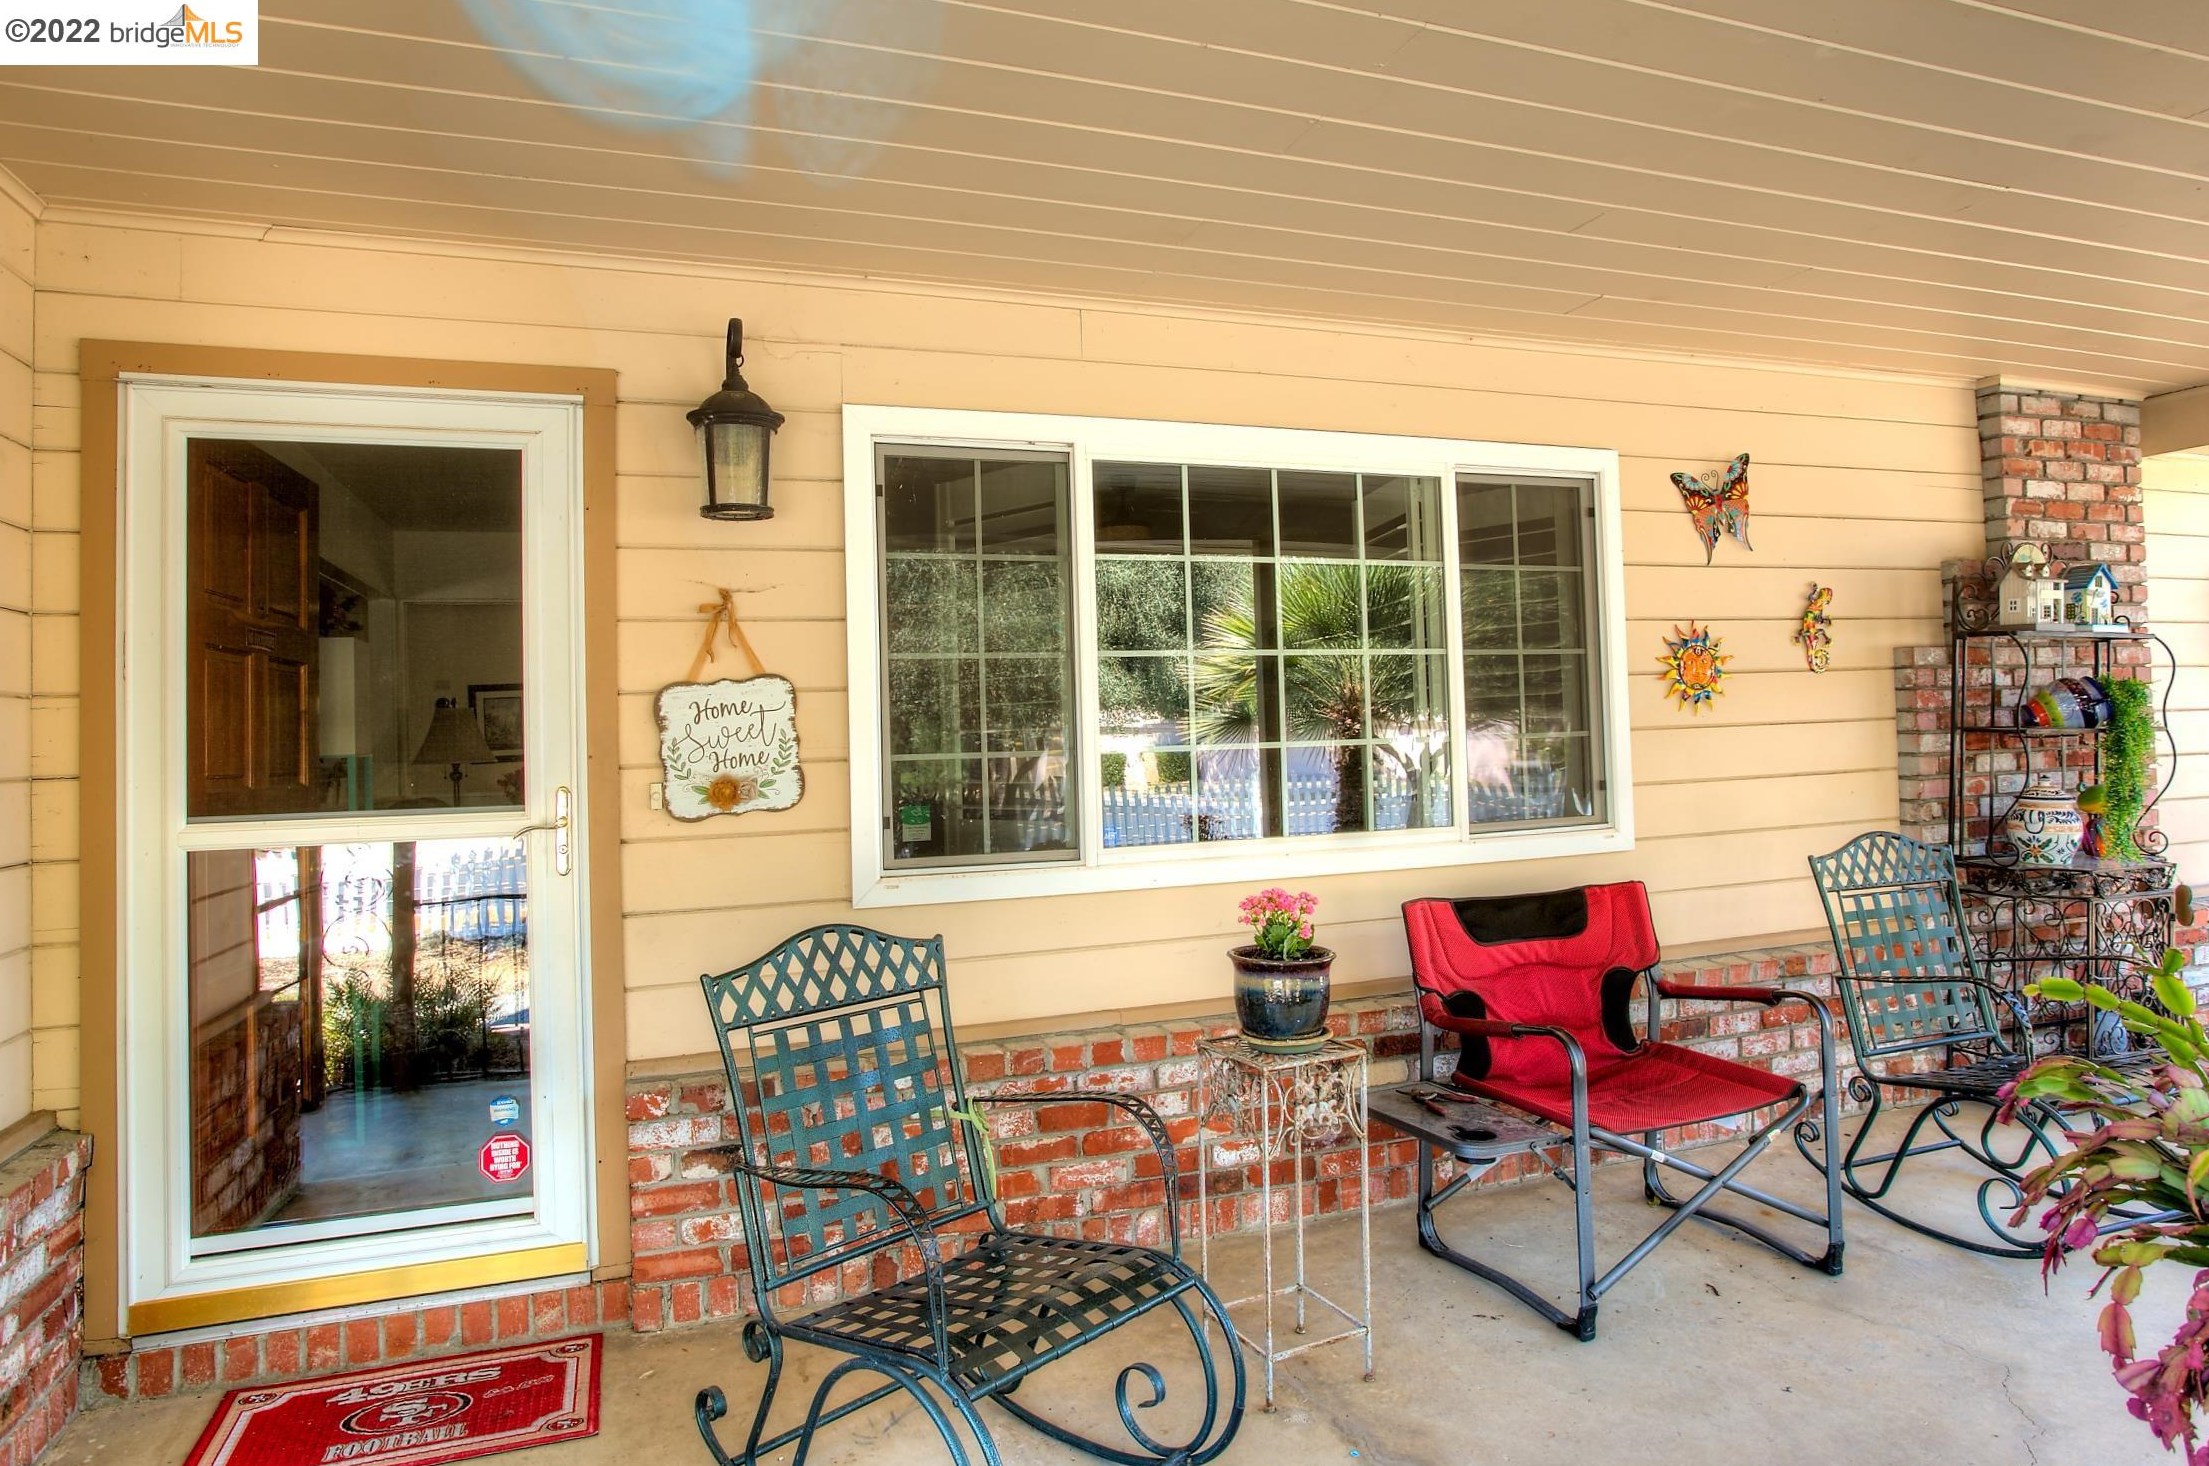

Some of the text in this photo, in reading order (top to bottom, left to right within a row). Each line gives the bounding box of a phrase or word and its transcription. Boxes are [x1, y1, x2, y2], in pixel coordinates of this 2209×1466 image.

[688, 698, 753, 725] Home
[708, 748, 770, 773] Home
[326, 1366, 502, 1407] 49ERS
[321, 1422, 468, 1462] FOOTBALL
